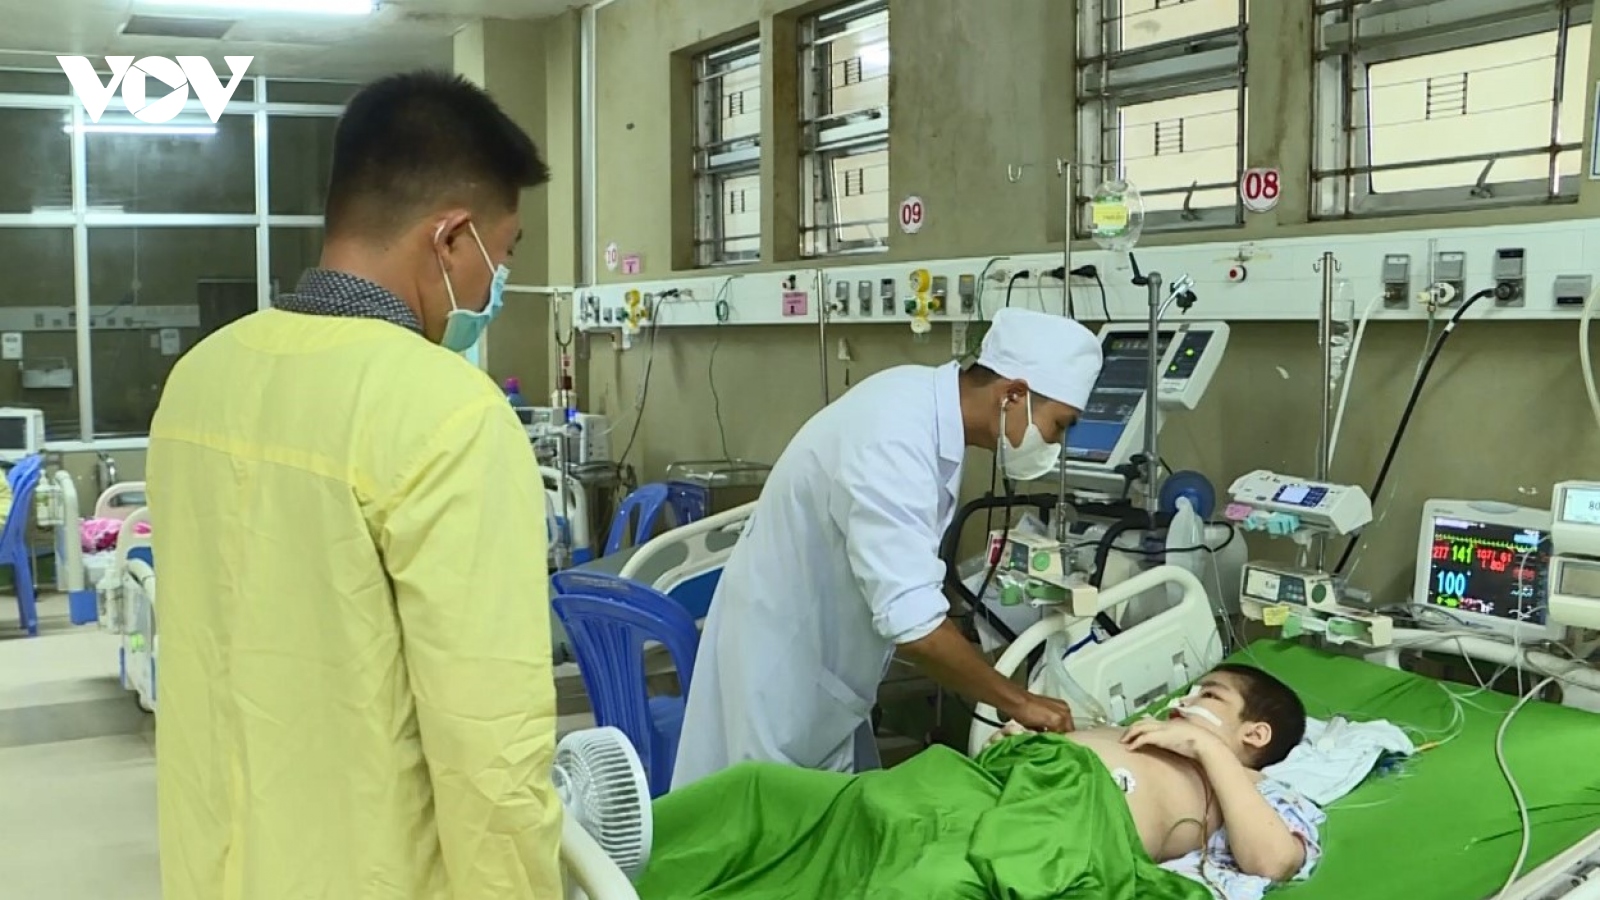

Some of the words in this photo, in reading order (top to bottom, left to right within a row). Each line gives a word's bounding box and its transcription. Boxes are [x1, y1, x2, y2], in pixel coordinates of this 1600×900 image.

[1246, 171, 1278, 199] 08
[903, 202, 921, 225] 09
[1452, 545, 1472, 564] 141
[1438, 571, 1465, 596] 100
